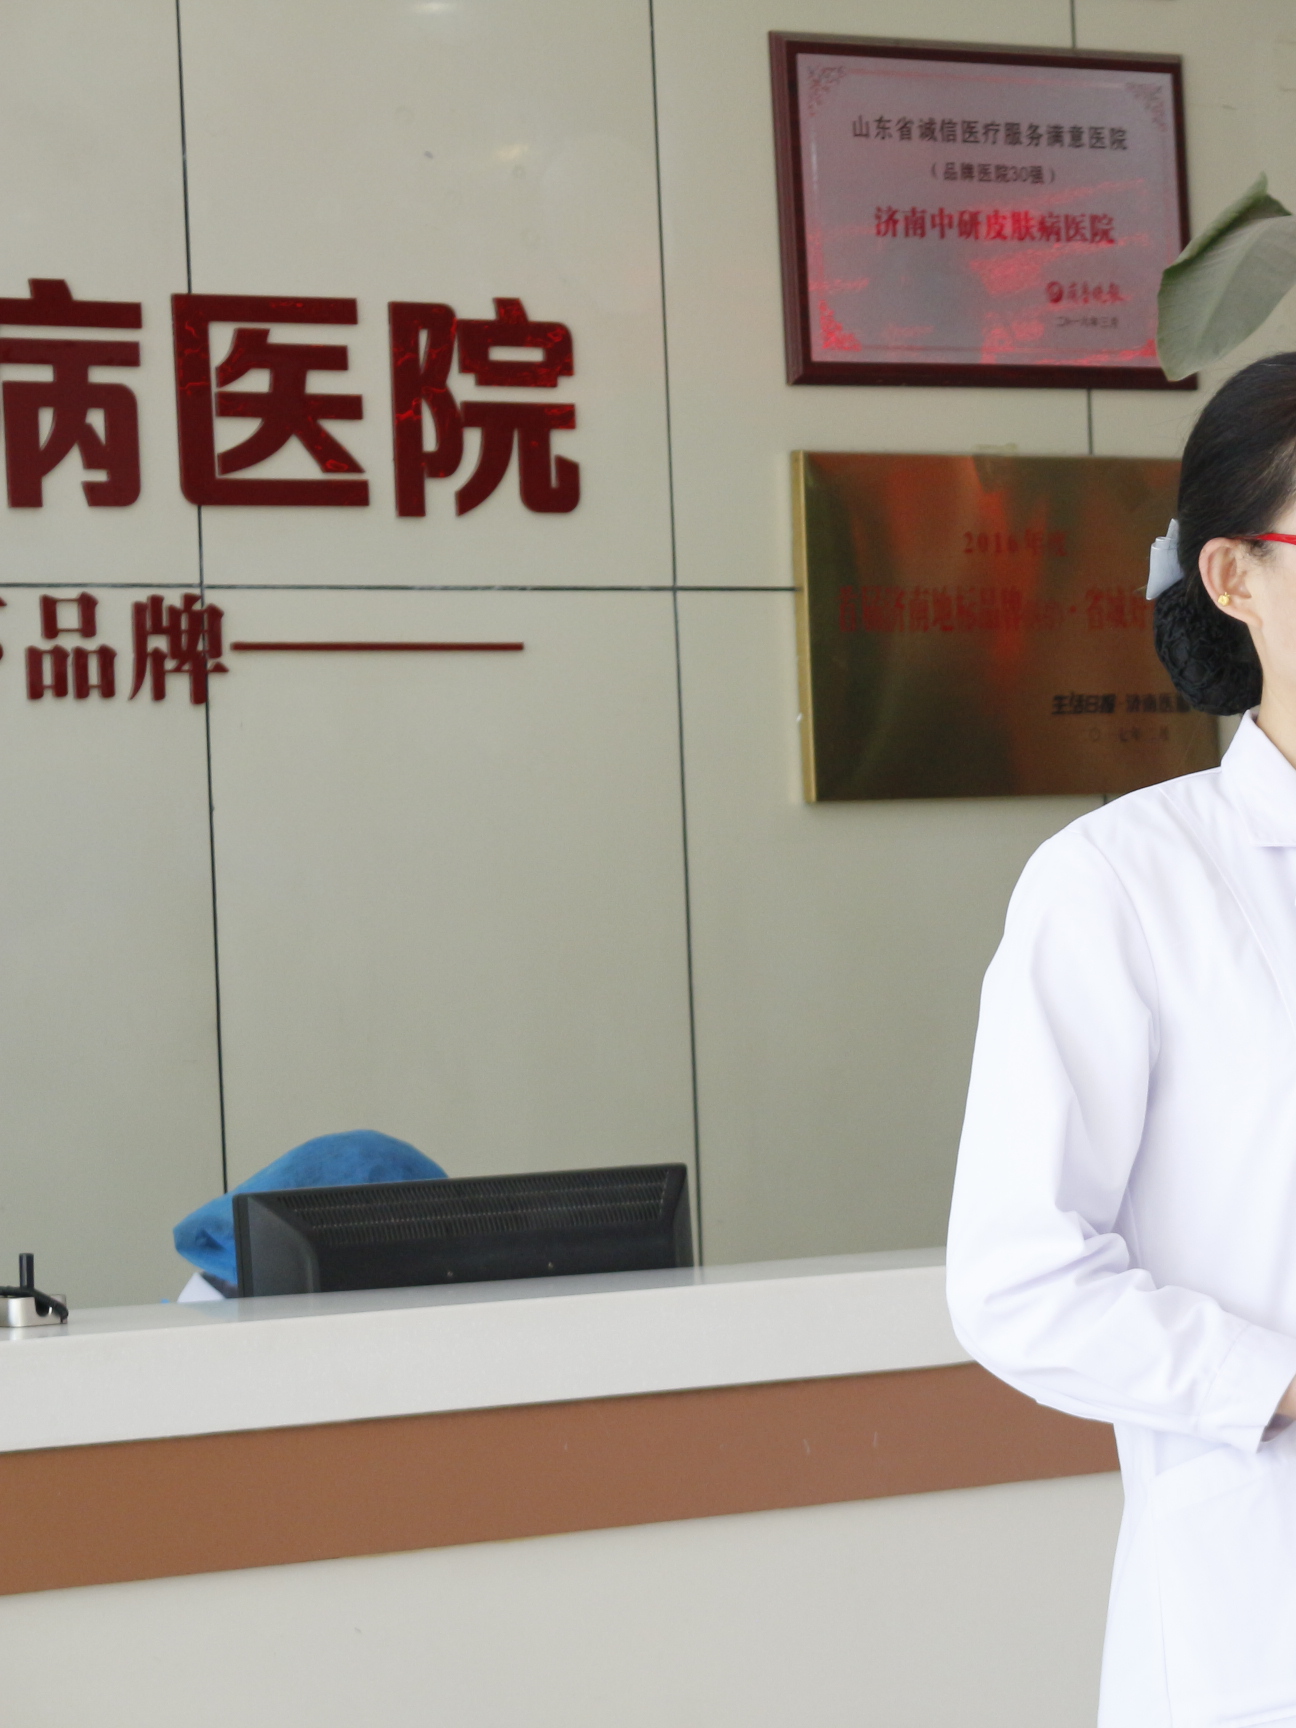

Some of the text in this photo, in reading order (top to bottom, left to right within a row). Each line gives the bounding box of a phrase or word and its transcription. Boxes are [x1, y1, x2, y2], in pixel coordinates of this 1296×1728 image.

[852, 115, 1128, 151] 山东省诚信医疗服务满意医院
[874, 205, 1116, 245] 济南中研皮肤病医院
[0, 278, 580, 518] 病医院
[0, 592, 229, 705] 品牌
